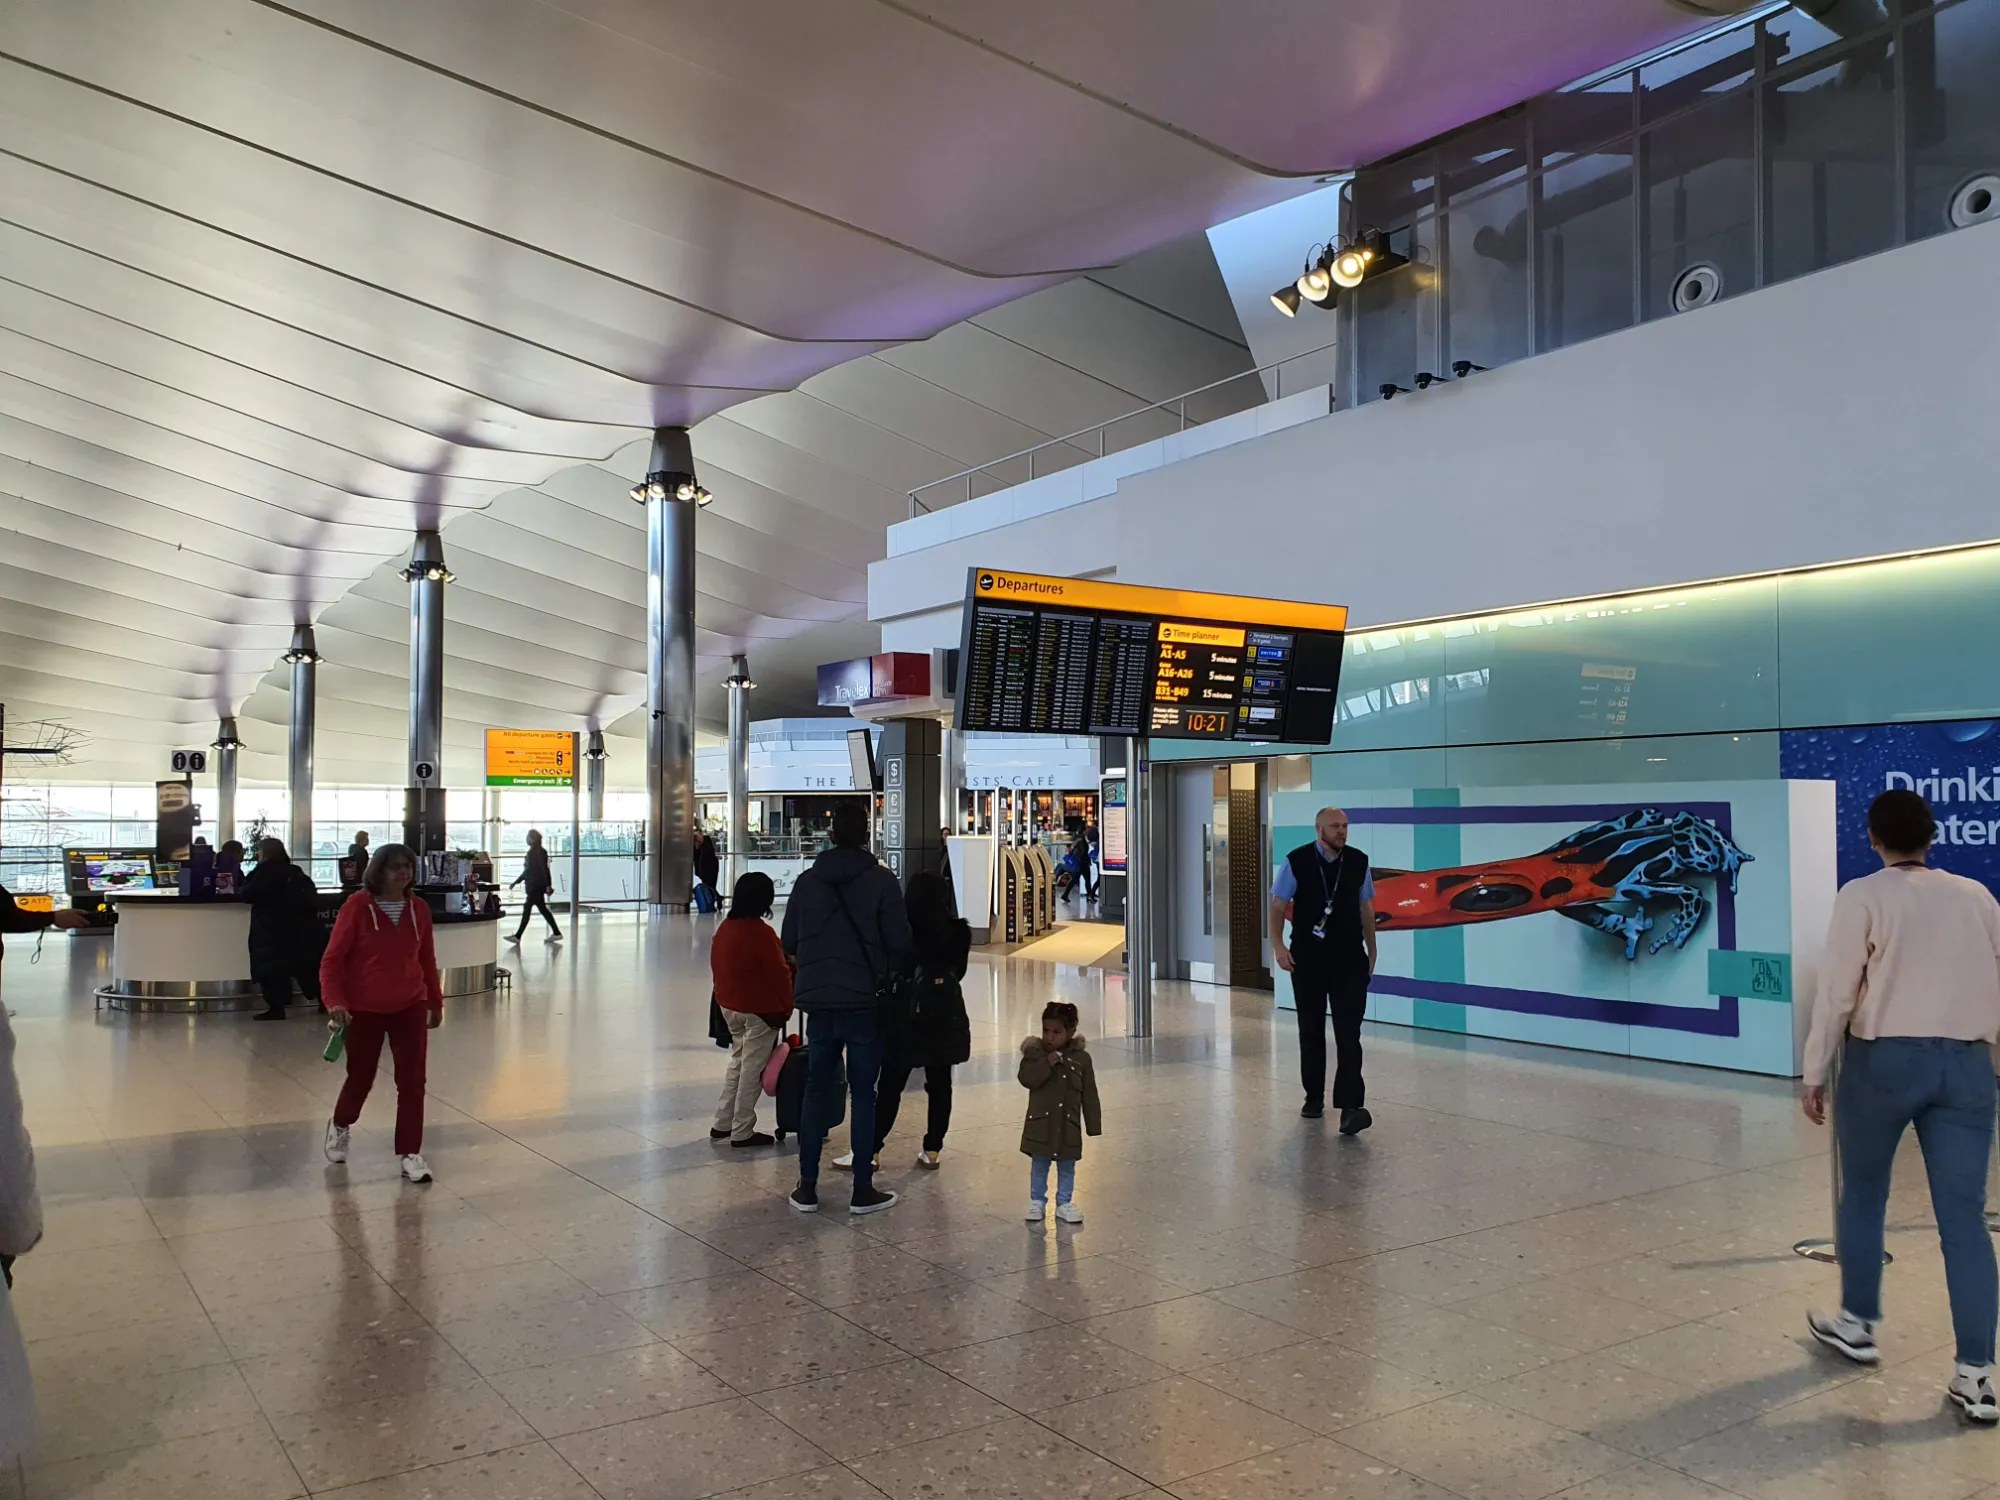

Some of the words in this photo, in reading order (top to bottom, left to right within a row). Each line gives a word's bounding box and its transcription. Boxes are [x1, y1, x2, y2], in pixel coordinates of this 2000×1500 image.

[997, 577, 1064, 595] Departures
[1173, 629, 1193, 638] Time
[1192, 631, 1220, 640] planner
[1160, 650, 1187, 660] A1-A5
[1211, 653, 1217, 662] 5
[1216, 656, 1237, 664] minutes
[1158, 668, 1193, 679] A16-A26
[1209, 671, 1215, 680] 5
[835, 682, 869, 701] Travelex
[1155, 686, 1190, 696] B31-B49
[1202, 689, 1212, 698] 15
[1188, 714, 1226, 732] 10:21
[804, 776, 837, 787] THE
[1012, 774, 1055, 787] CAFÉ
[1931, 814, 2000, 845] ater
